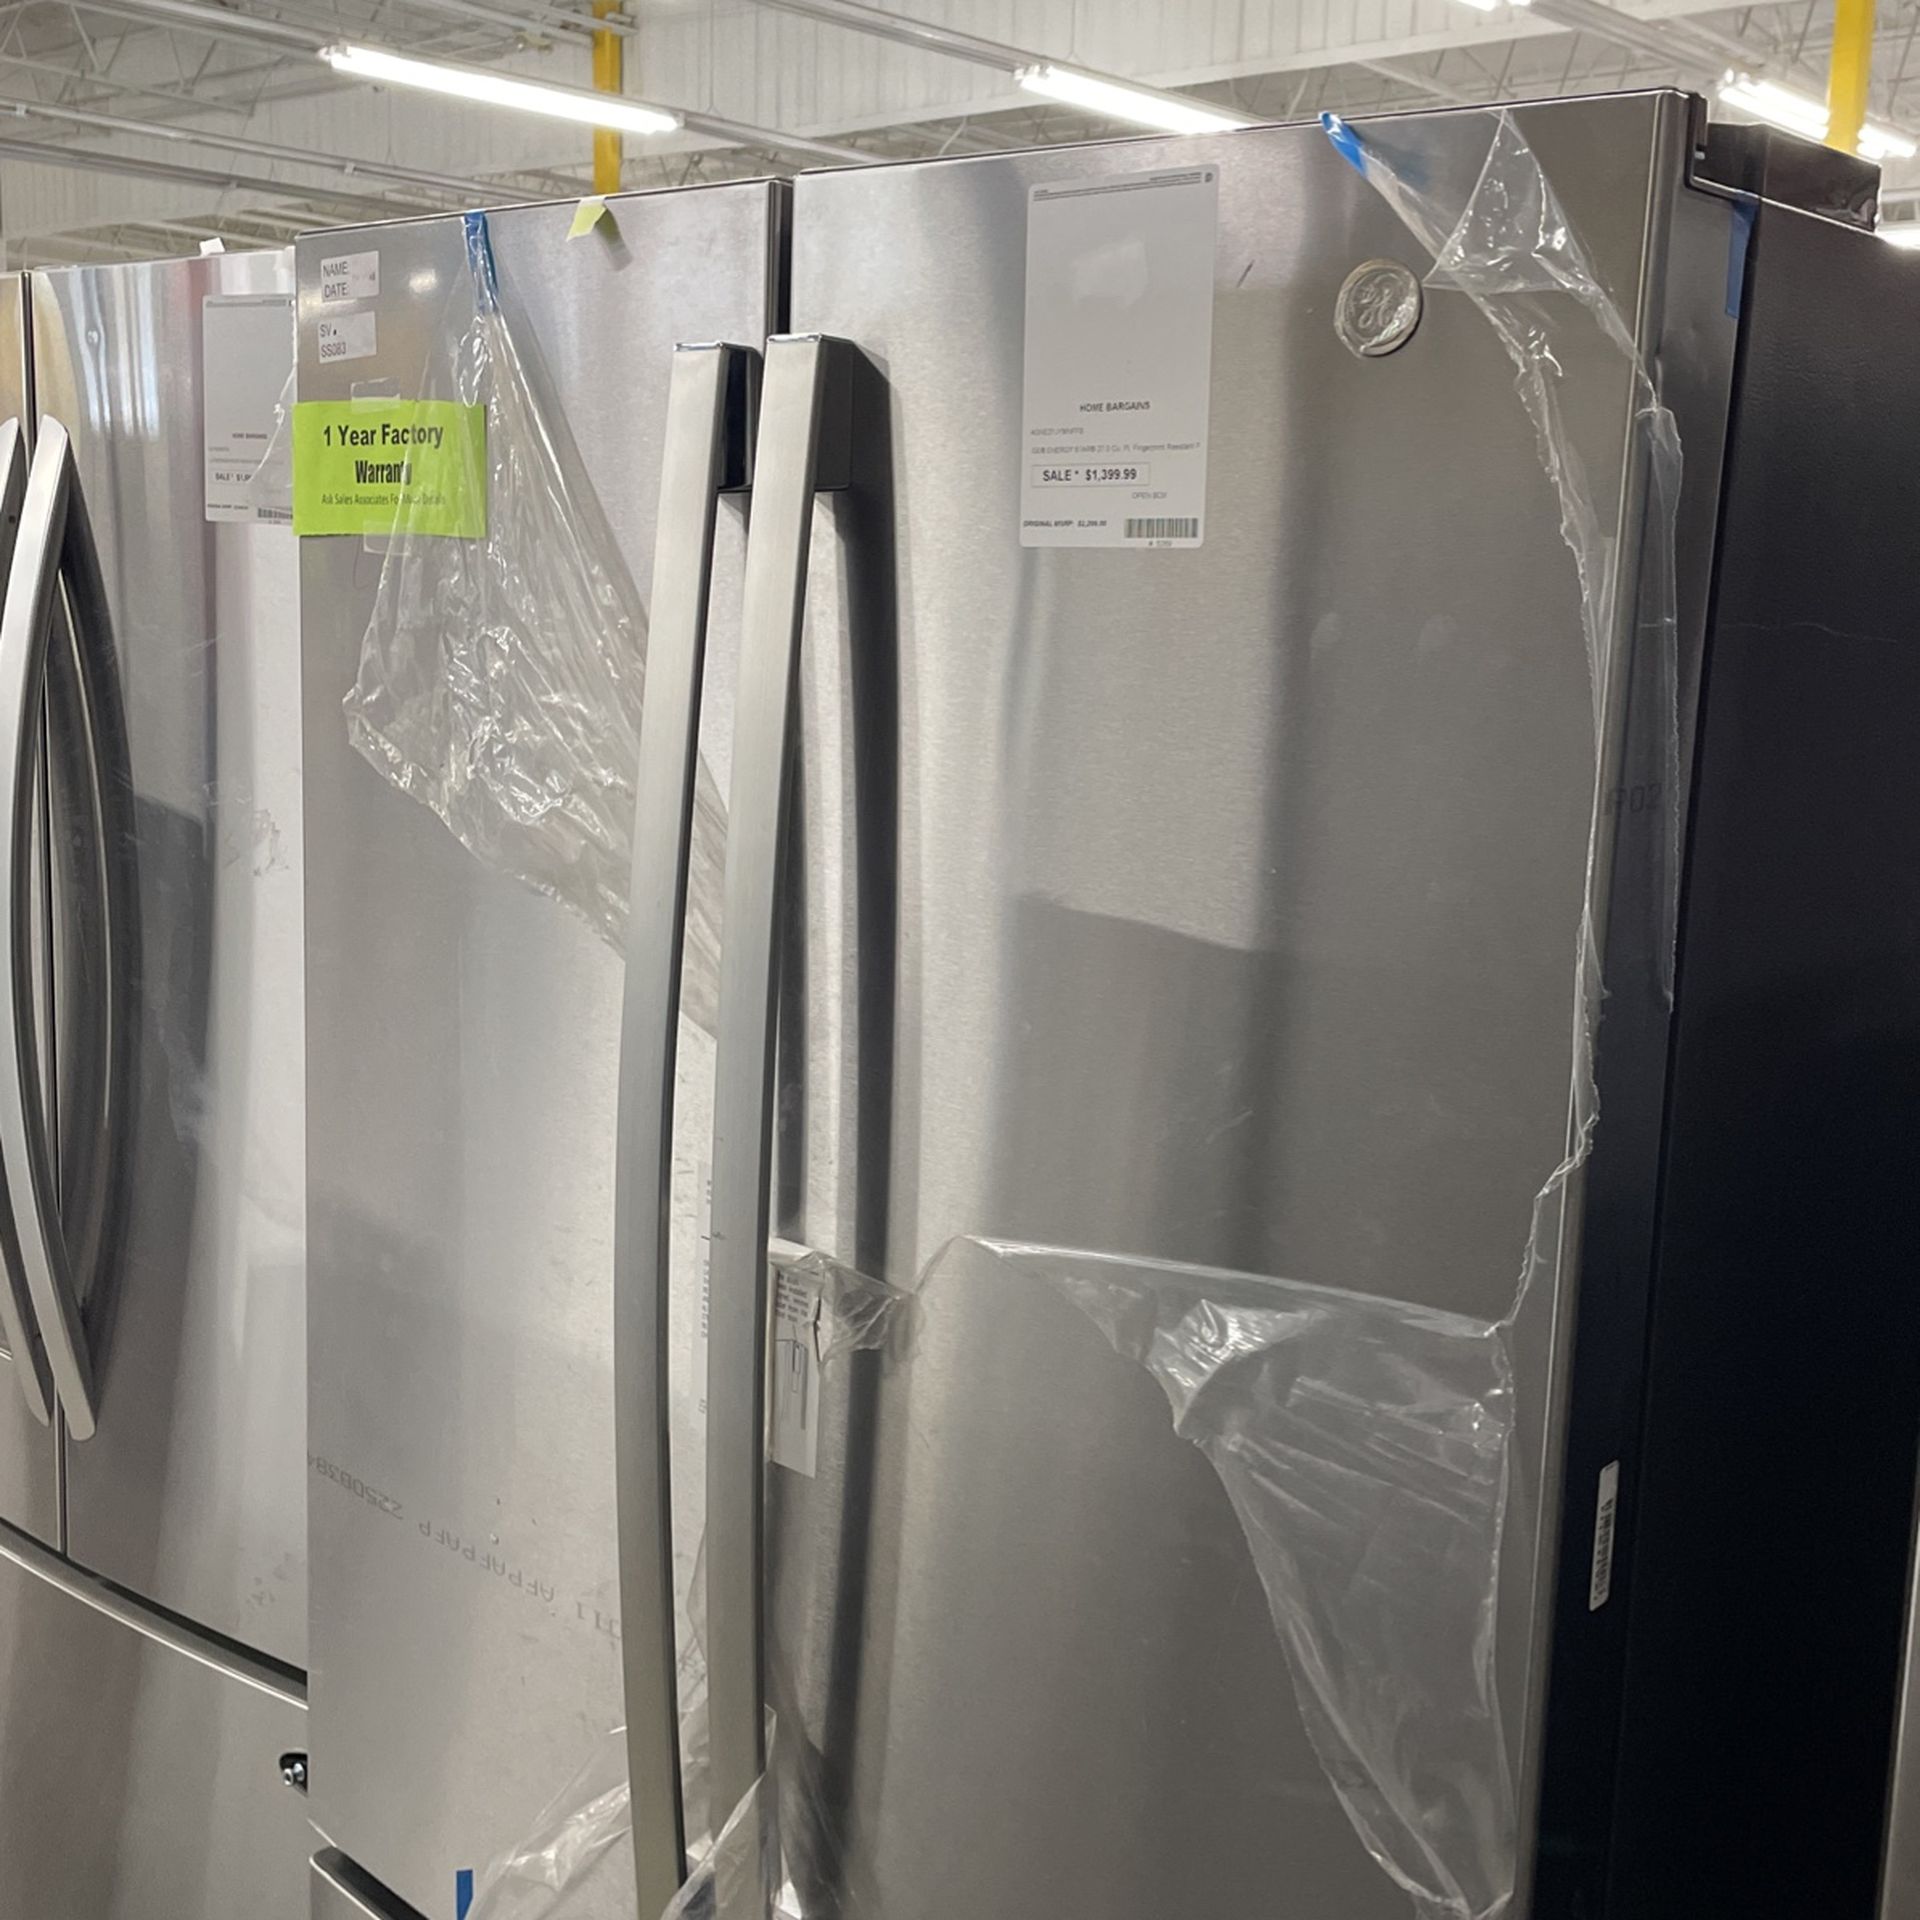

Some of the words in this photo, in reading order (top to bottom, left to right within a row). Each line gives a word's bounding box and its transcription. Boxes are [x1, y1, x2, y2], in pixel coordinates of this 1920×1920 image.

[323, 425, 331, 447] 1
[338, 425, 376, 446] Year
[381, 424, 444, 449] Factory
[1043, 469, 1072, 481] SALE
[1085, 468, 1137, 481] $1,399.99
